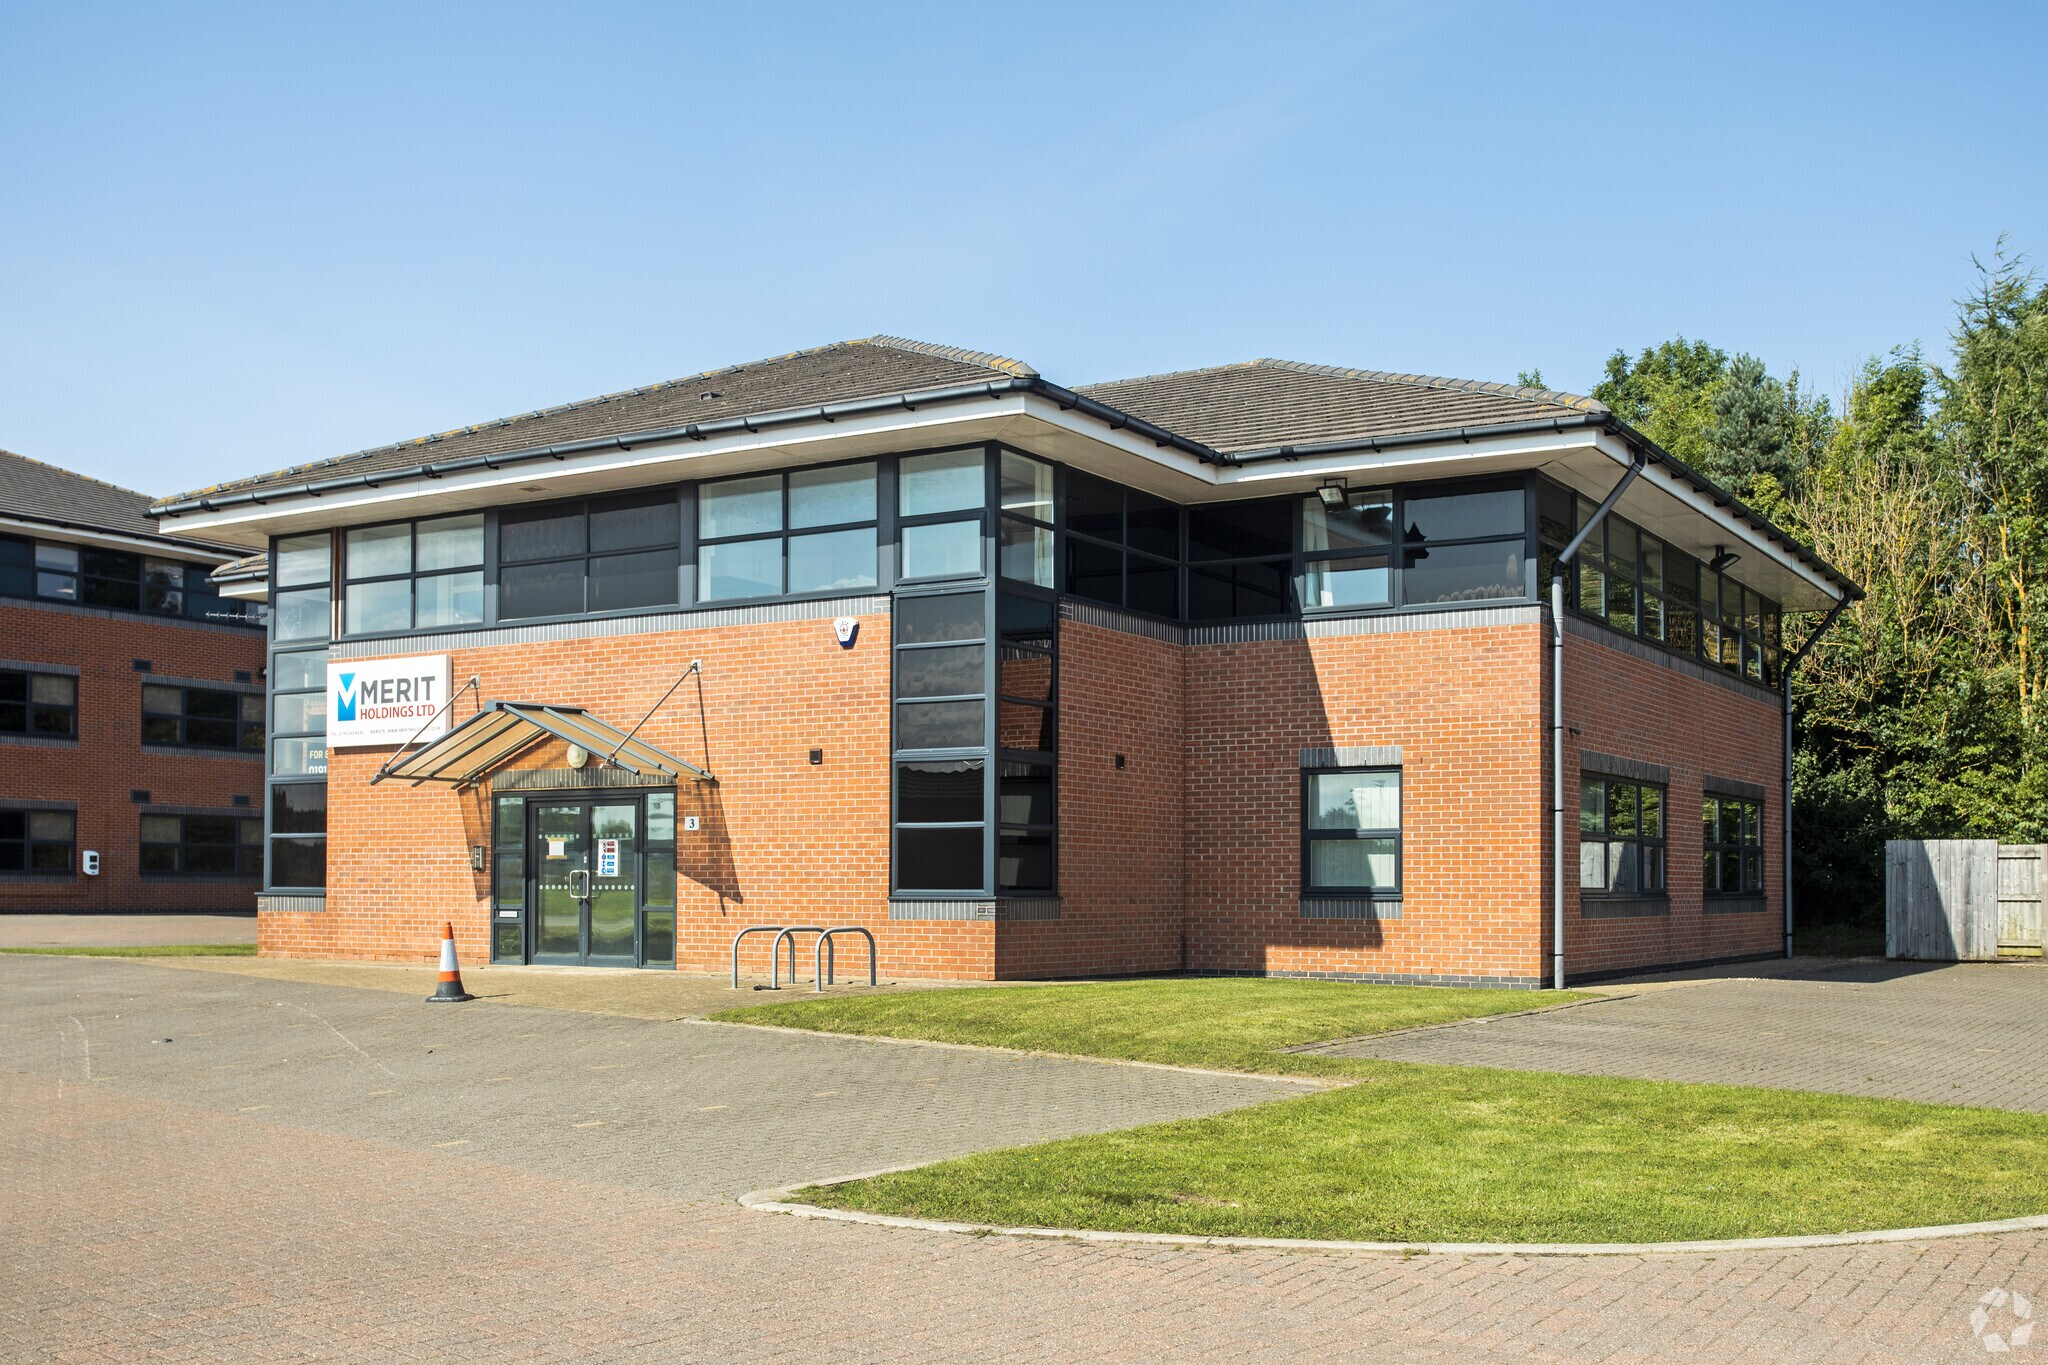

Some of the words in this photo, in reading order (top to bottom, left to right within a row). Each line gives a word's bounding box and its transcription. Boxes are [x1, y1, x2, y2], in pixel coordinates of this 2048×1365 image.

[361, 676, 436, 705] MERIT
[360, 705, 414, 720] HOLDINGS
[417, 704, 436, 717] LTD
[310, 750, 324, 759] FOR
[689, 818, 695, 829] 3
